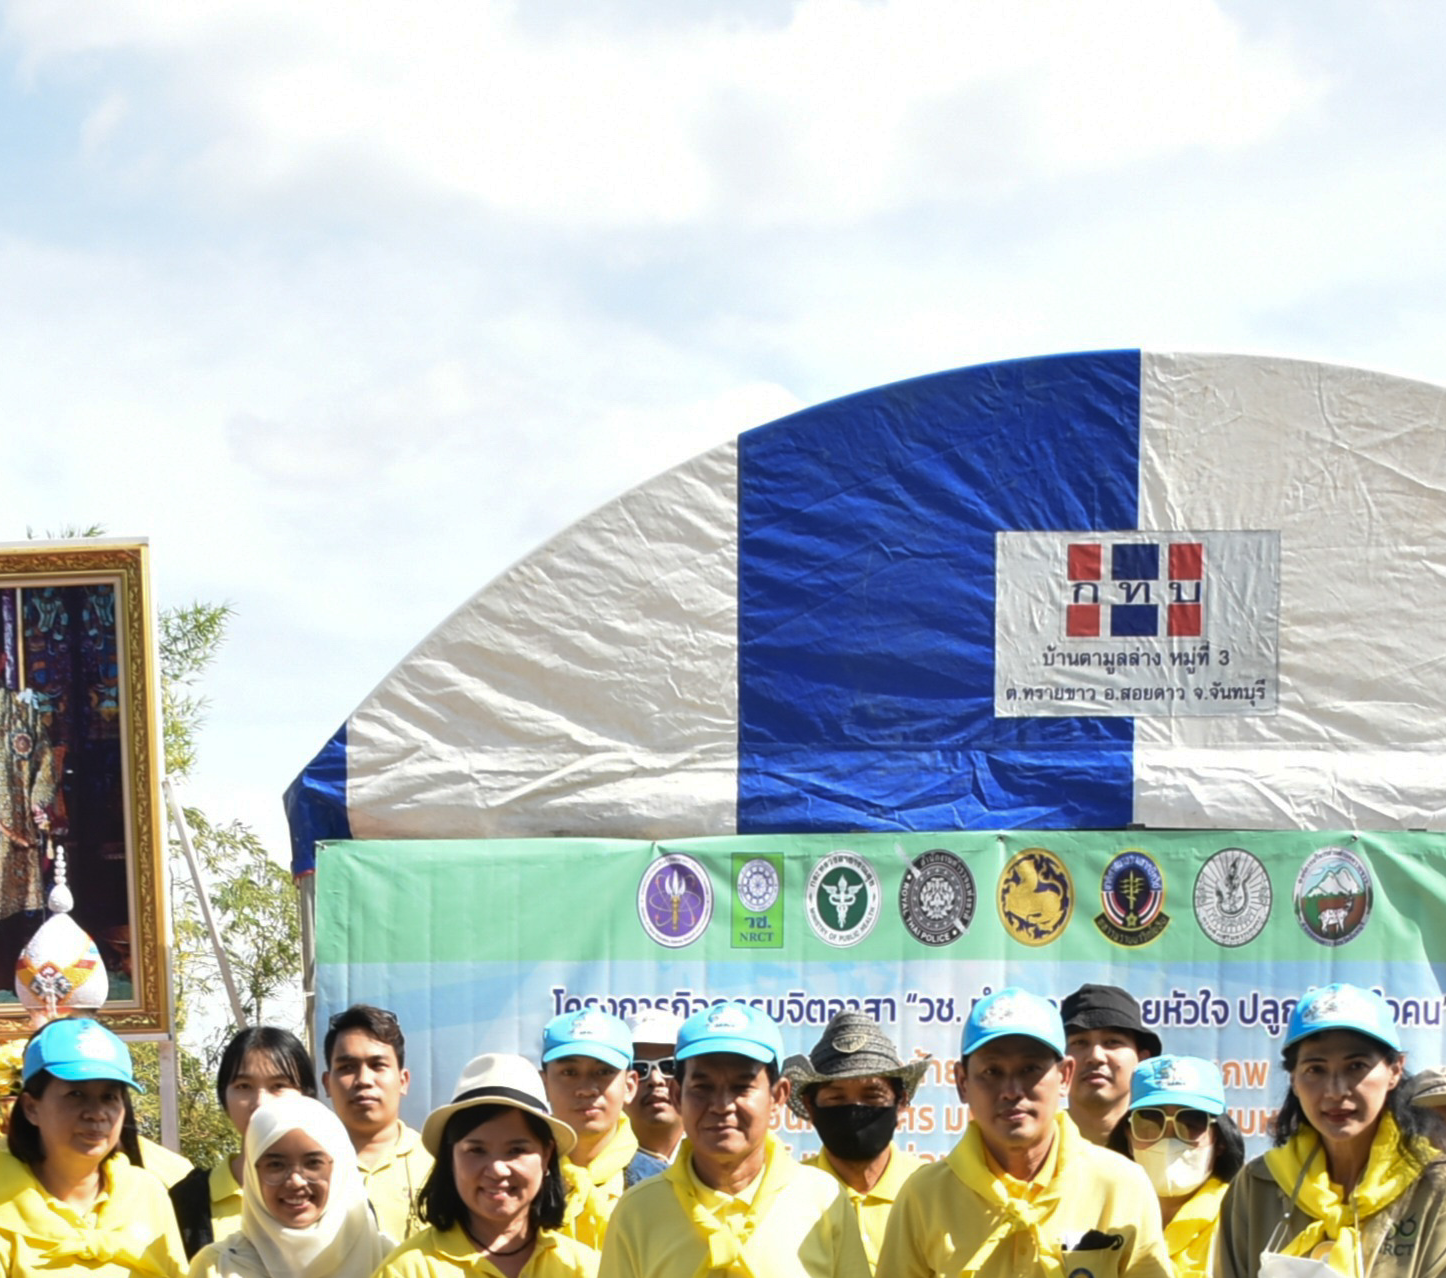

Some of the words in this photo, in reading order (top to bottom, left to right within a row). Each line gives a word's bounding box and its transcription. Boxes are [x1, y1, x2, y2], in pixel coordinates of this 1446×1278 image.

[1042, 646, 1162, 675] บ้านตามูลล่าง
[1170, 642, 1211, 675] หมู่ที่
[1218, 650, 1231, 666] 3
[1005, 686, 1097, 701] ต.ทรายขาว
[1103, 686, 1186, 701] อ.สอยดาว
[1193, 679, 1267, 707] จ.จันทบุรี
[744, 916, 772, 929] วช.
[906, 917, 921, 936] THAI
[921, 932, 951, 943] POLICE
[739, 932, 774, 942] NRCT
